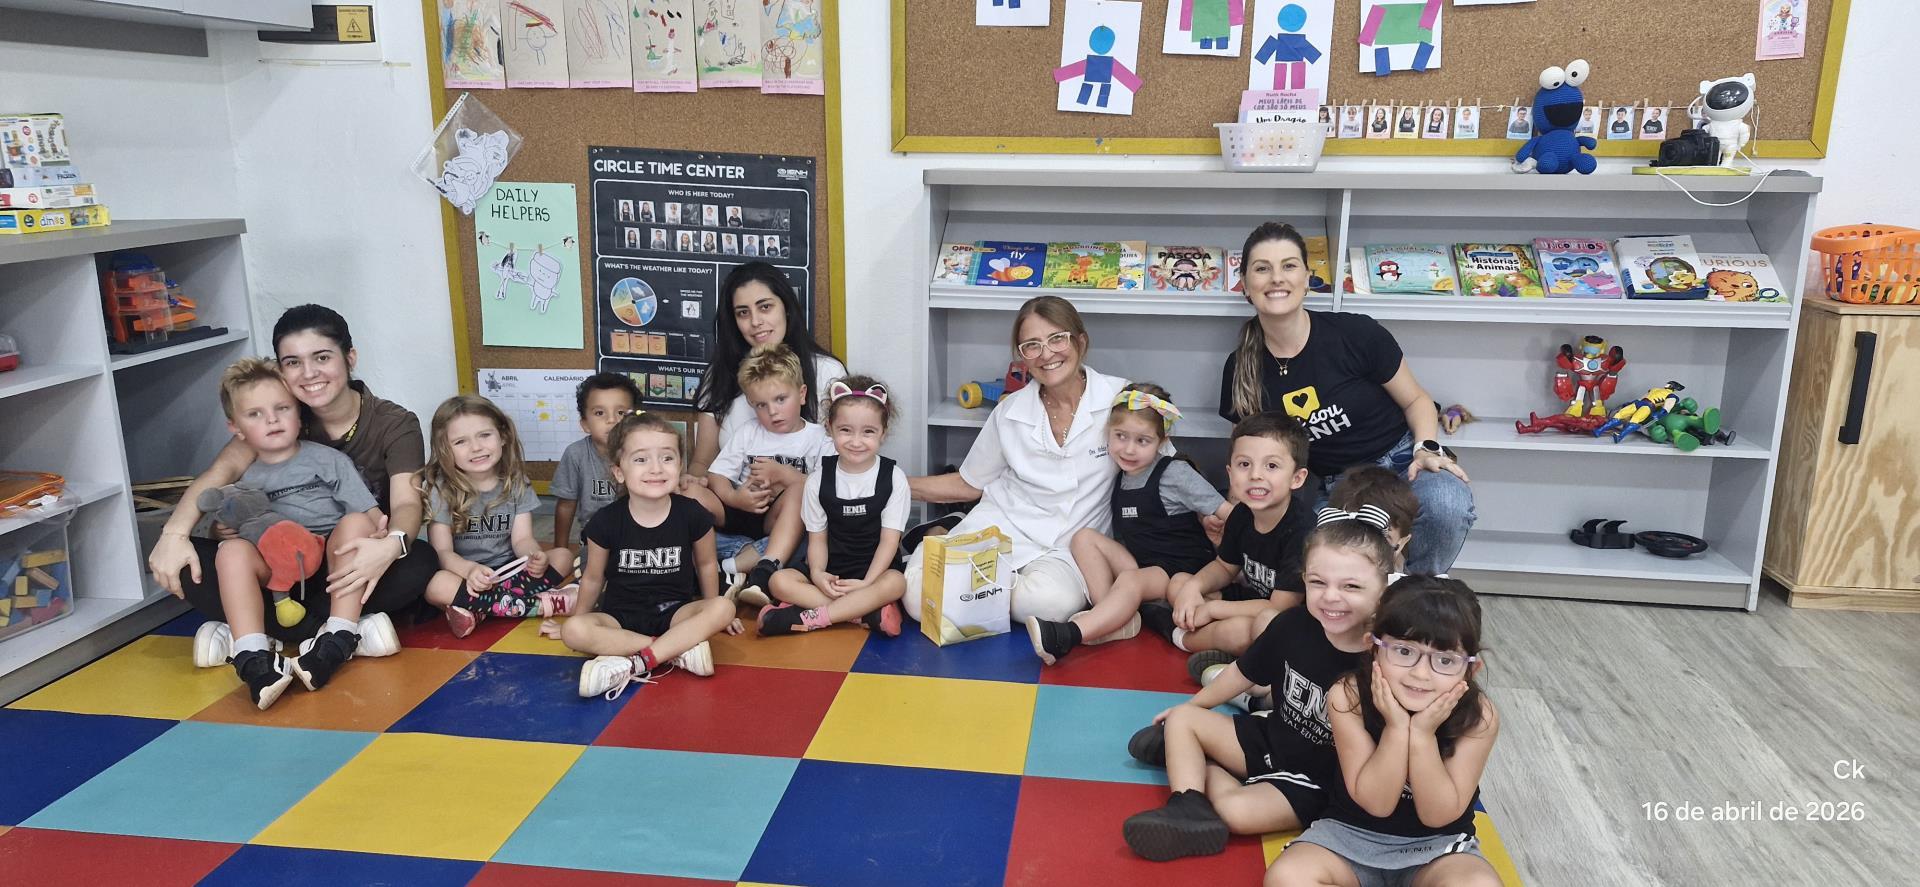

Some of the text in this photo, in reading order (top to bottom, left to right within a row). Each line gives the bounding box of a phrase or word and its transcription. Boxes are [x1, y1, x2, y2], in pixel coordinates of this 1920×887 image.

[594, 159, 745, 179] CIRCLE TIME CENTER
[496, 188, 539, 202] DAILY
[668, 189, 684, 197] WHO
[693, 190, 709, 198] HERE
[710, 191, 735, 199] TODAY?
[491, 203, 551, 222] HELPERS
[1010, 250, 1026, 260] fly
[1472, 257, 1520, 266] Histórias
[604, 262, 629, 270] WHAT'S
[642, 264, 673, 273] WEATHER
[687, 267, 713, 275] TODAY?
[1477, 263, 1520, 272] Animais
[657, 365, 682, 373] WHAT'S
[1309, 404, 1343, 424] sou
[1309, 413, 1352, 442] NH
[591, 479, 618, 496] IEN
[843, 504, 867, 513] IENH
[466, 512, 512, 533] ENH
[619, 546, 682, 569] IENH
[650, 566, 680, 575] EDUCATION
[974, 587, 1003, 601] IENH
[1282, 660, 1333, 732] IEN
